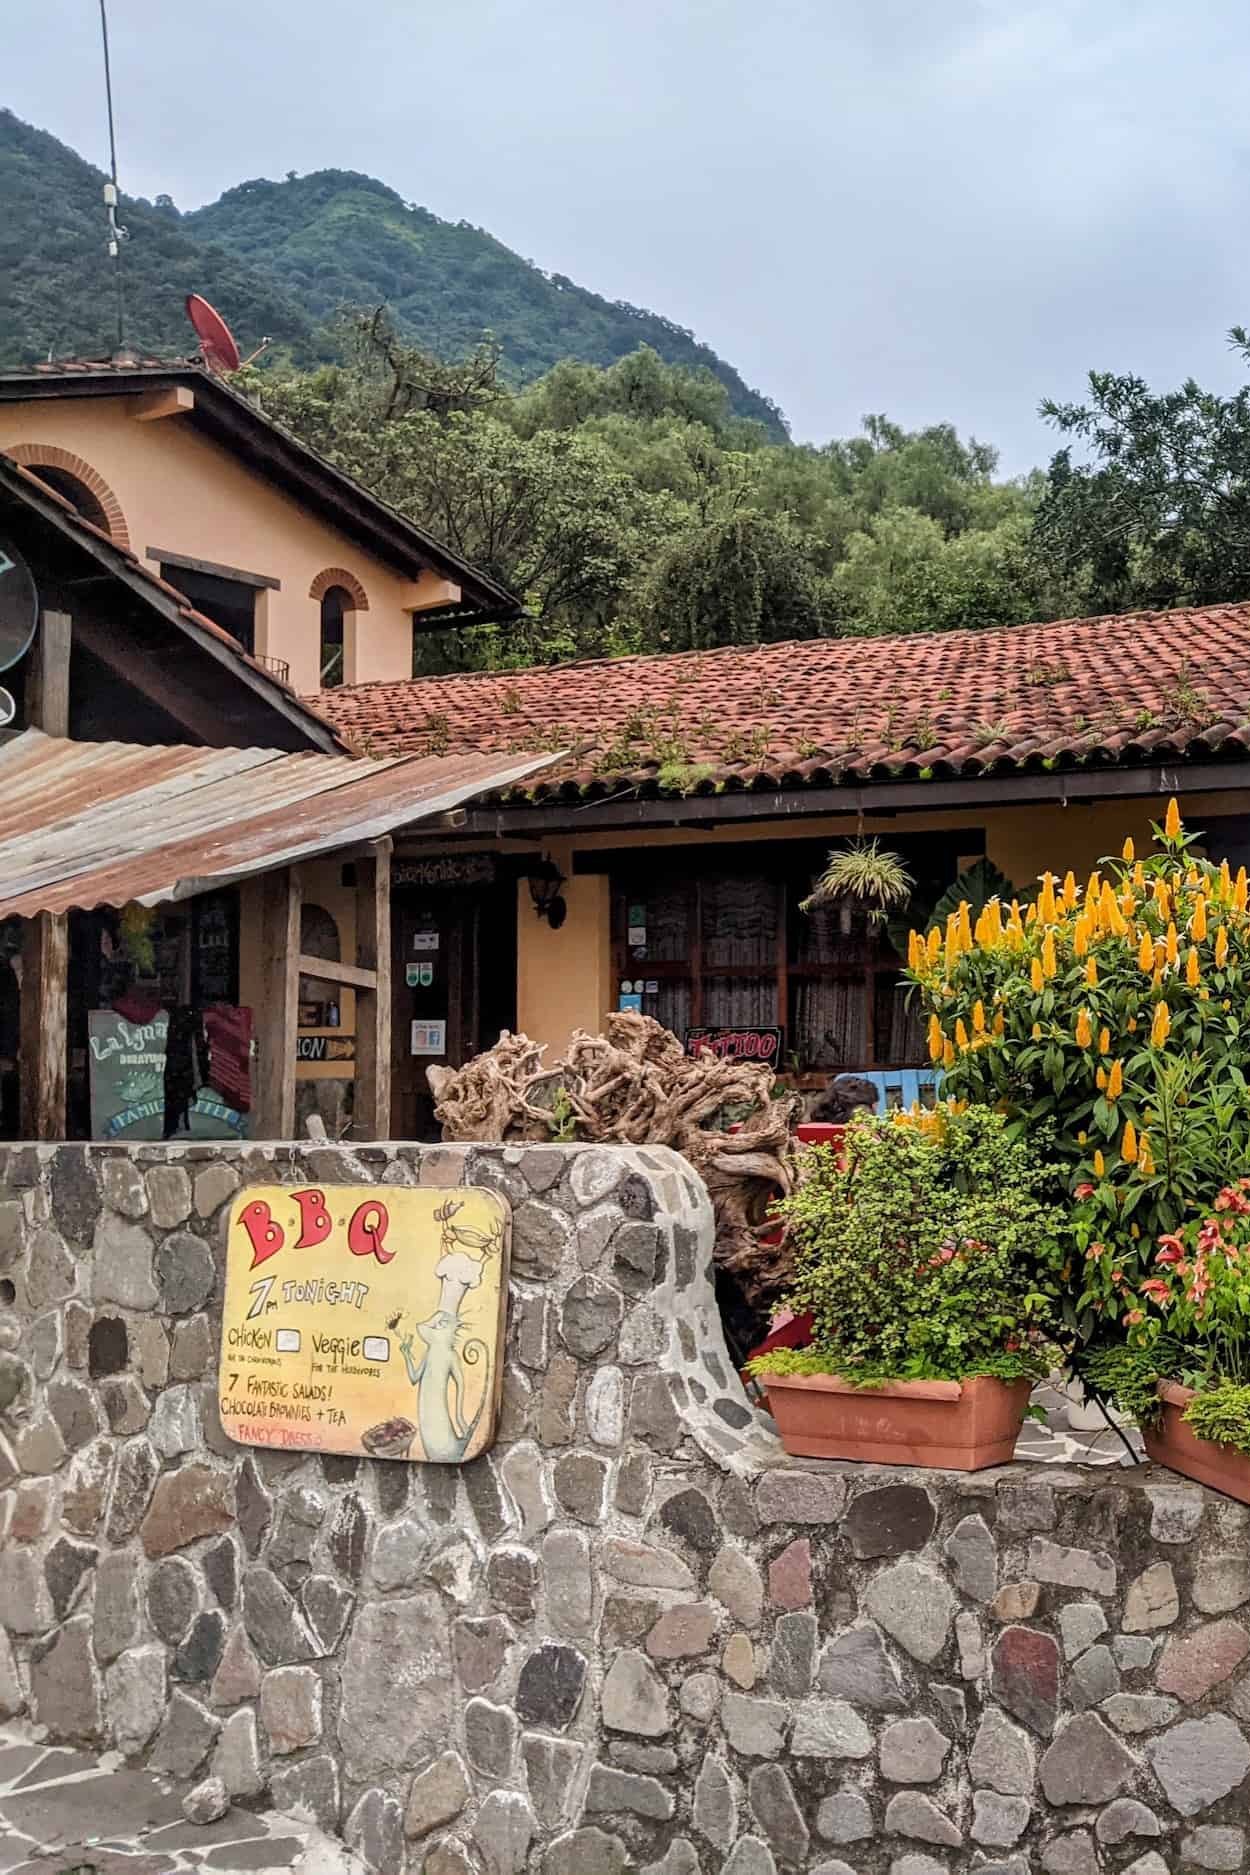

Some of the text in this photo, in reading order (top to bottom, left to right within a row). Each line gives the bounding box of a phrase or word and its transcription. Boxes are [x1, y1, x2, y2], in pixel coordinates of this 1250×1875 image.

[312, 1332, 361, 1365] Veggie
[229, 1373, 239, 1392] 7
[327, 1407, 347, 1427] TEA
